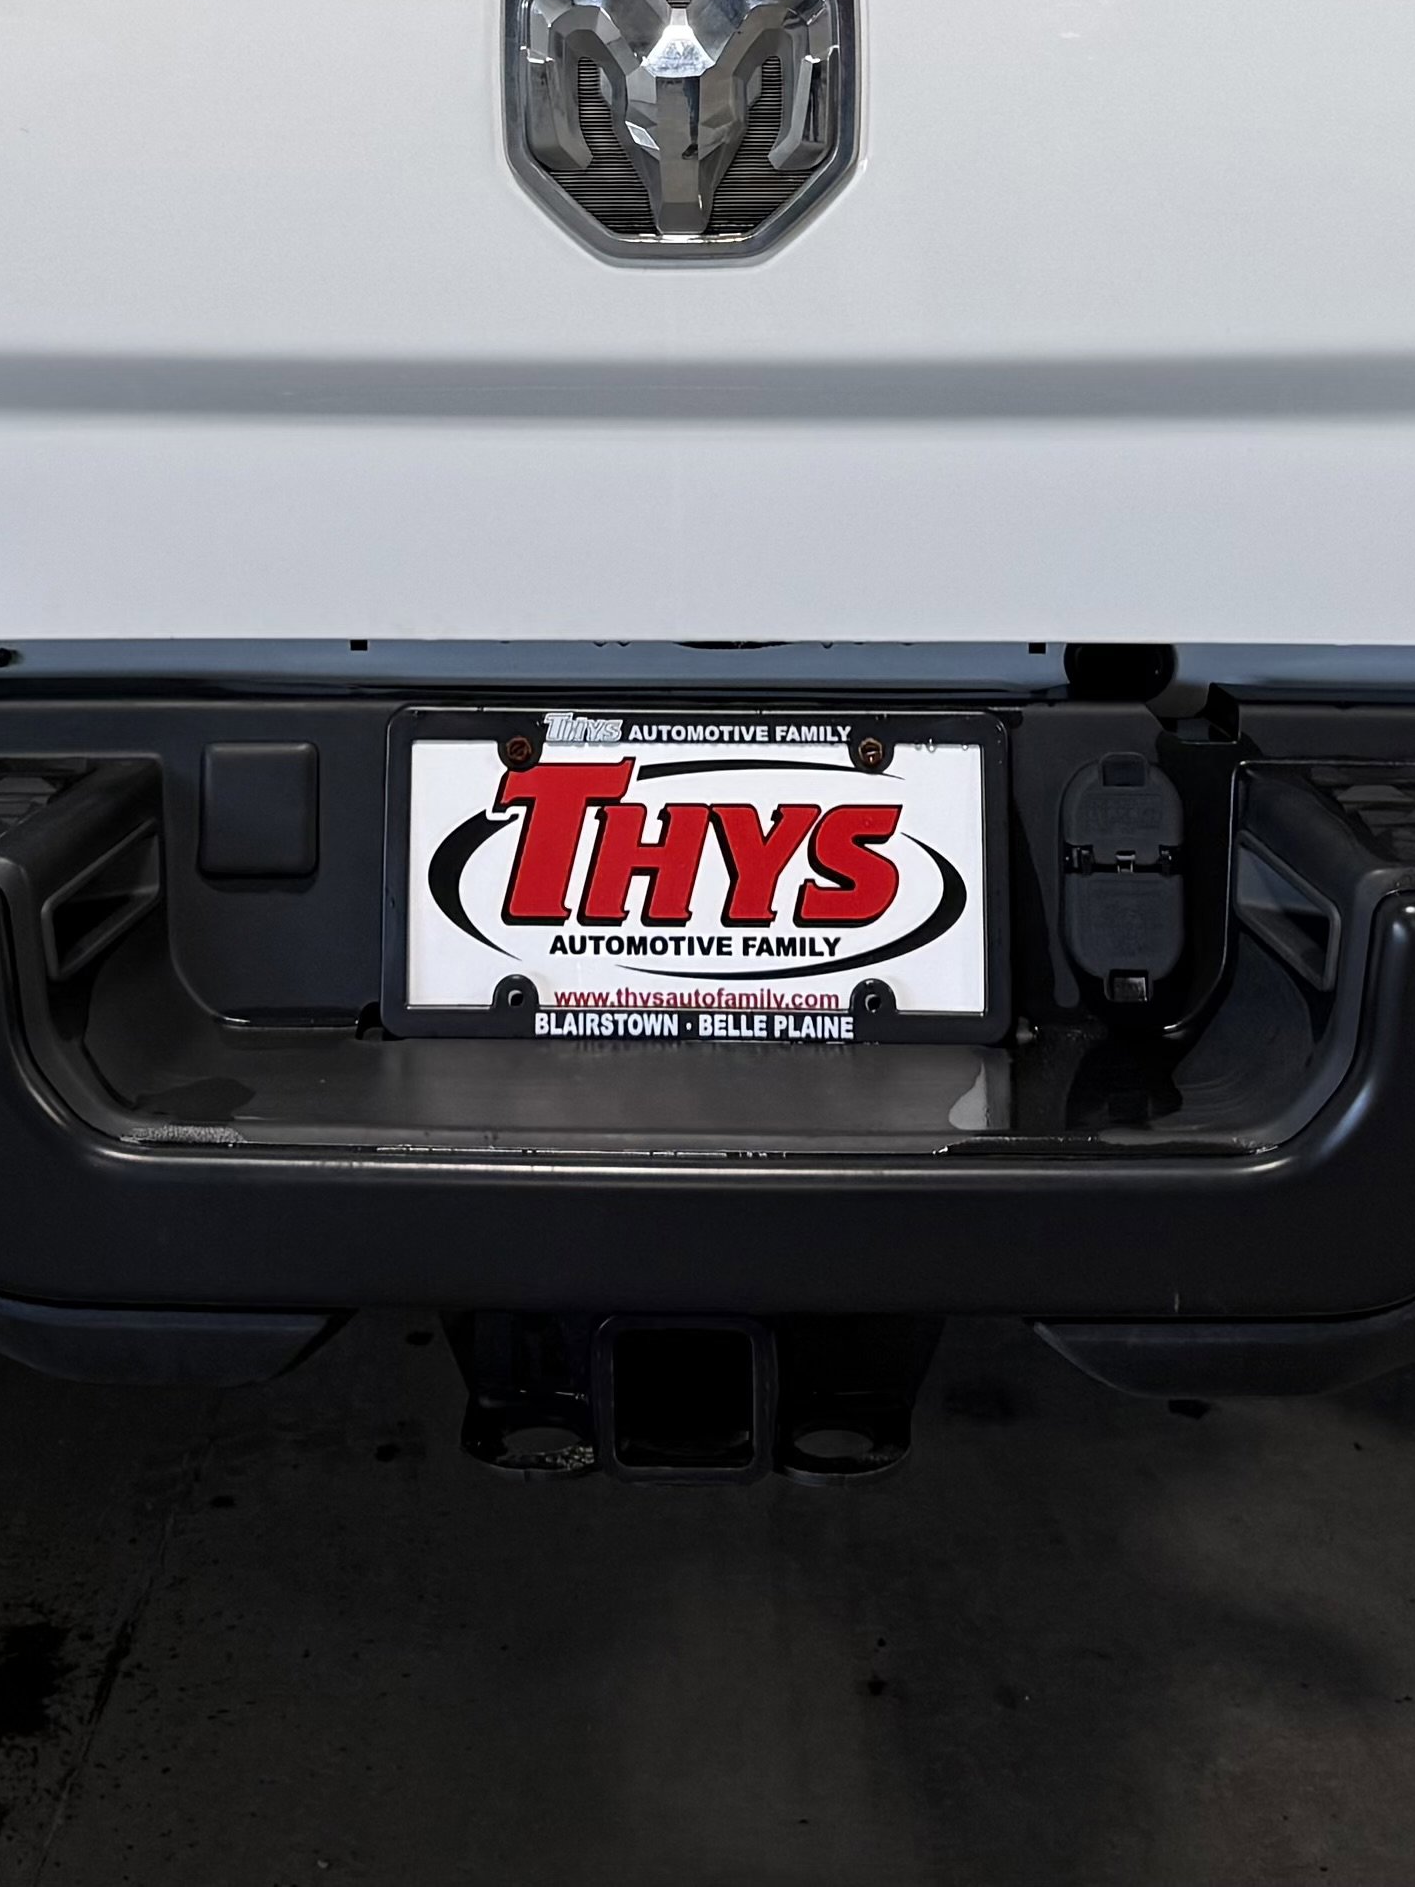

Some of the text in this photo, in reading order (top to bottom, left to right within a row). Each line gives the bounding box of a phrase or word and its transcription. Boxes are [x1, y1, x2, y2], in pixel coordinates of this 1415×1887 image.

[628, 724, 769, 742] AUTOMOTIVE
[775, 724, 852, 743] FAMILY
[491, 757, 904, 928] THYS
[549, 935, 842, 958] AUTOMOTIVE FAMILY
[554, 987, 840, 1010] www.thysautofamily.com
[534, 1012, 854, 1040] BLAIRSTOWN BELLE PLAINE
